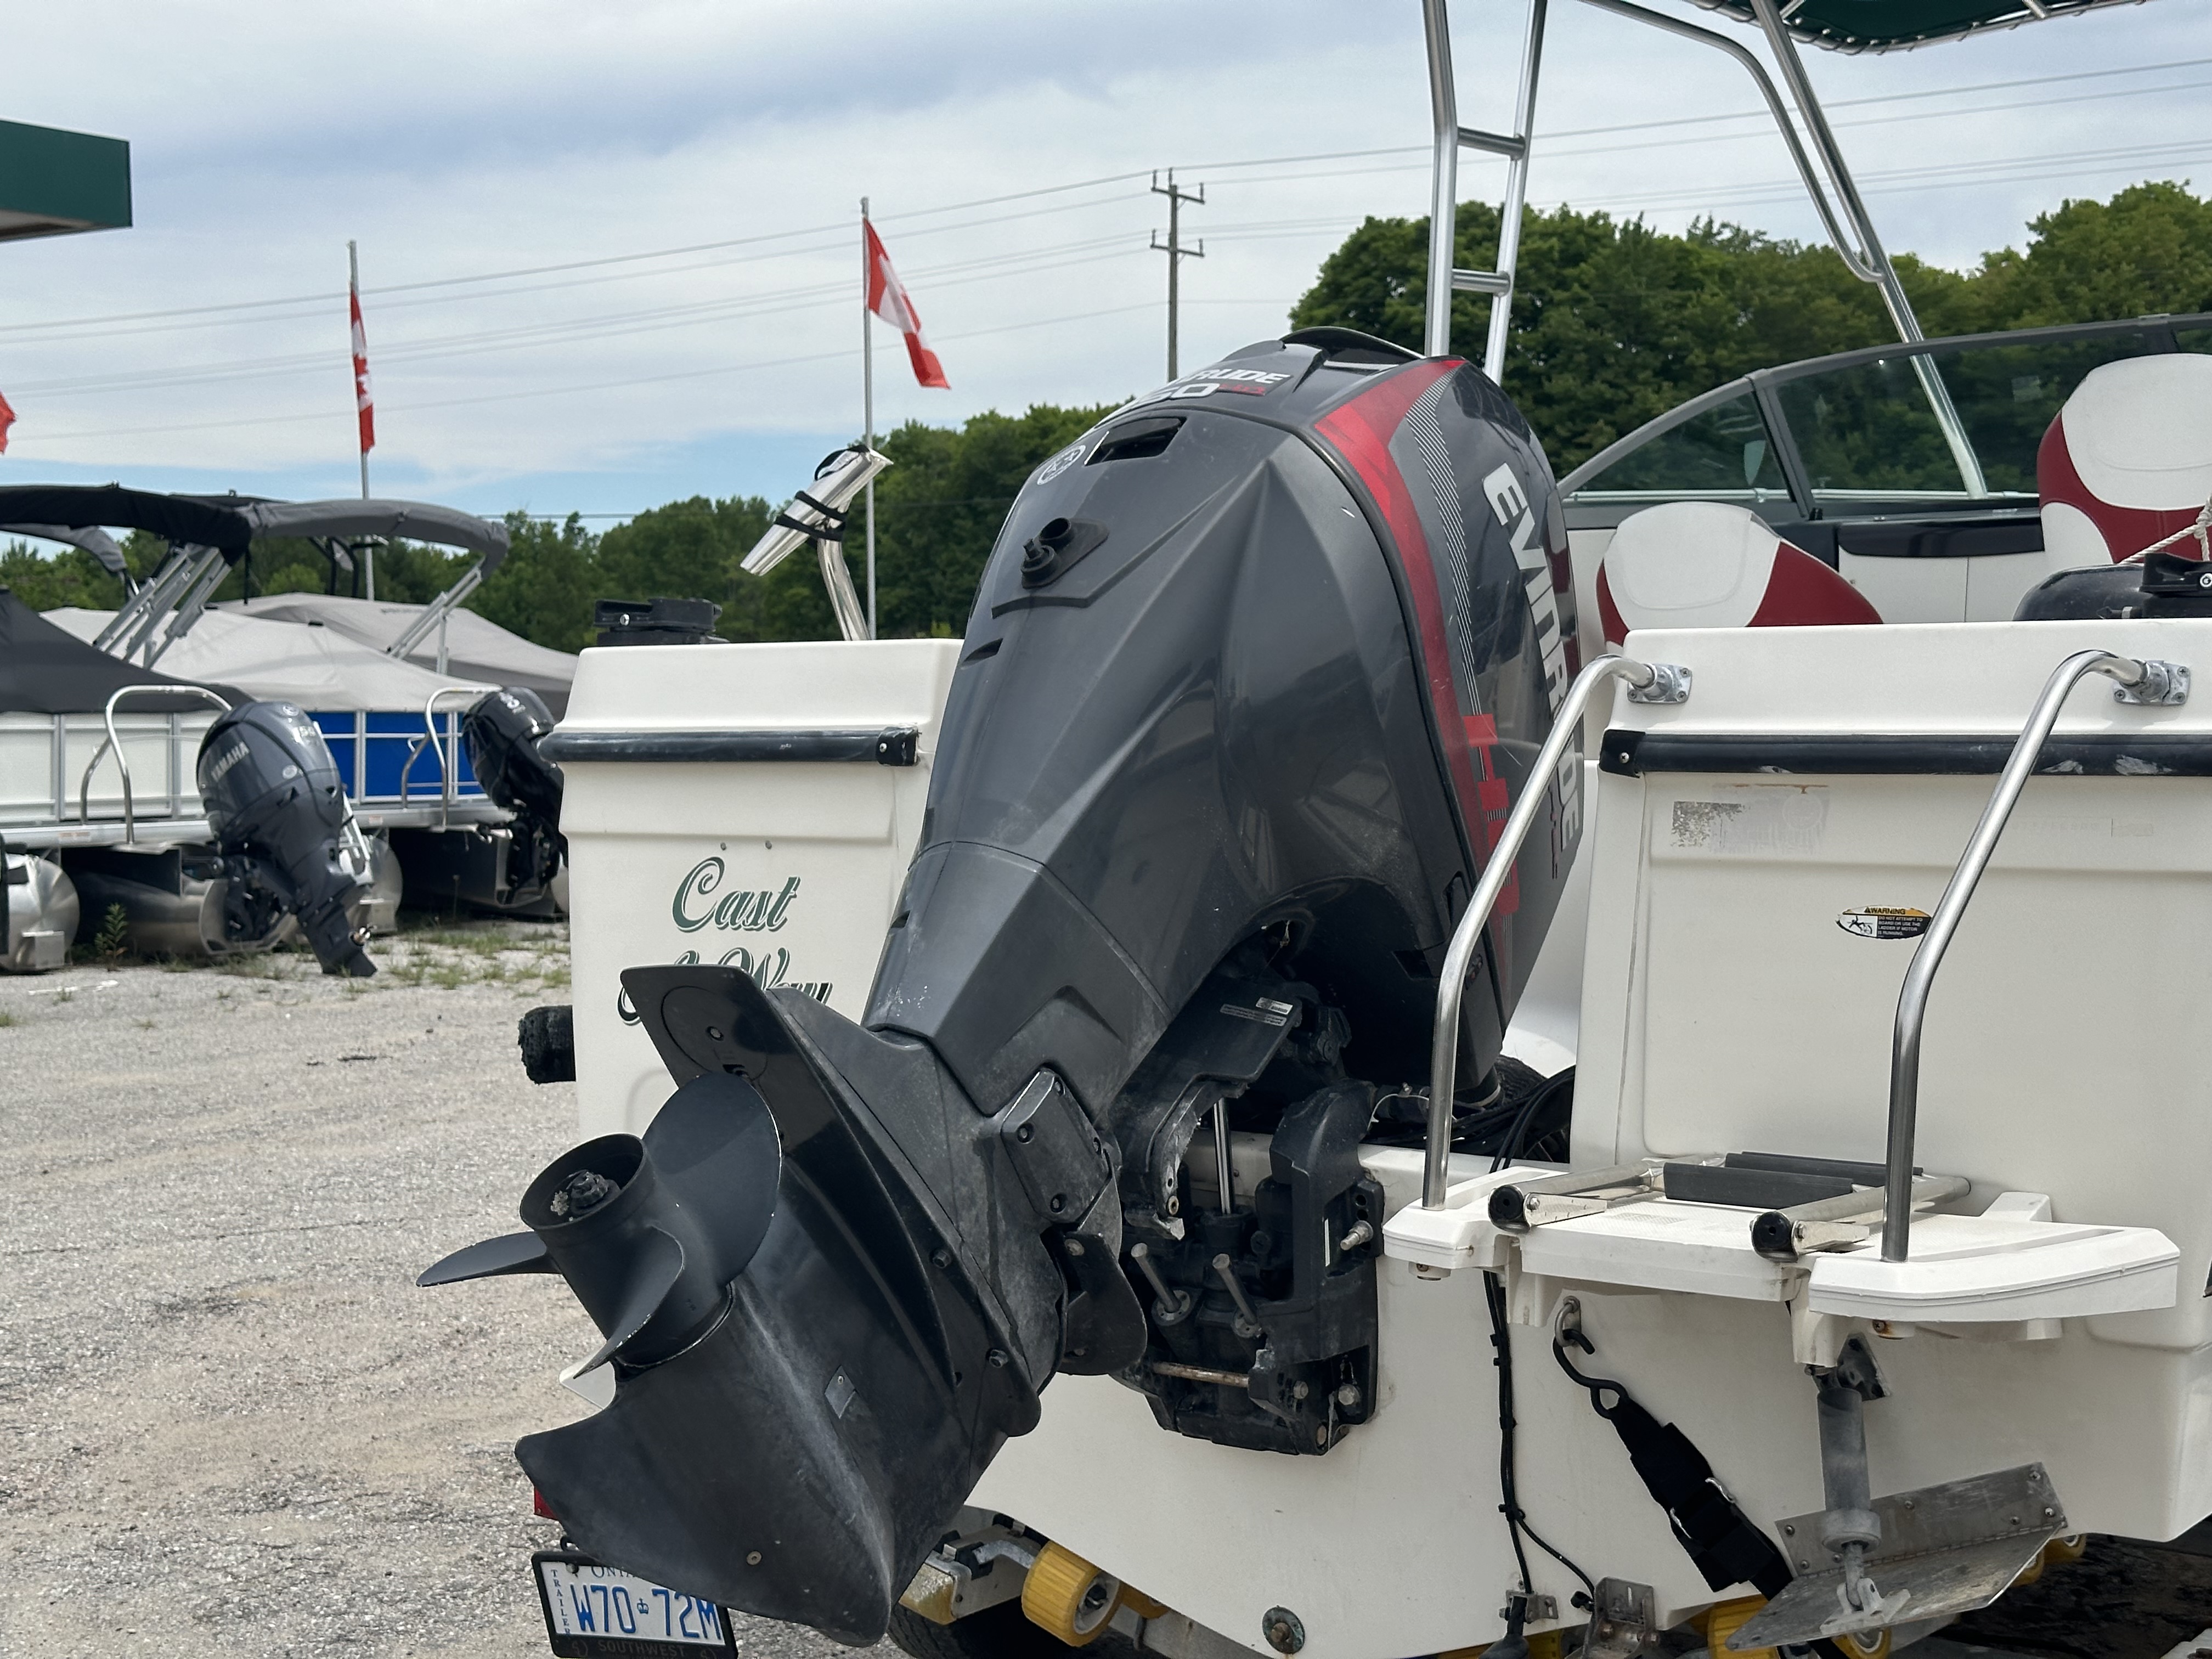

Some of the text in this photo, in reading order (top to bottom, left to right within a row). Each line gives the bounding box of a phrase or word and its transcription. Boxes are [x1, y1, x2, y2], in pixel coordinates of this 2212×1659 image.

[1483, 462, 1579, 850] EVINRDE
[211, 741, 250, 783] YAMAHA
[672, 856, 801, 932] Cast
[569, 1584, 721, 1640] W70 72M
[597, 1639, 686, 1657] SOUTHWEST
